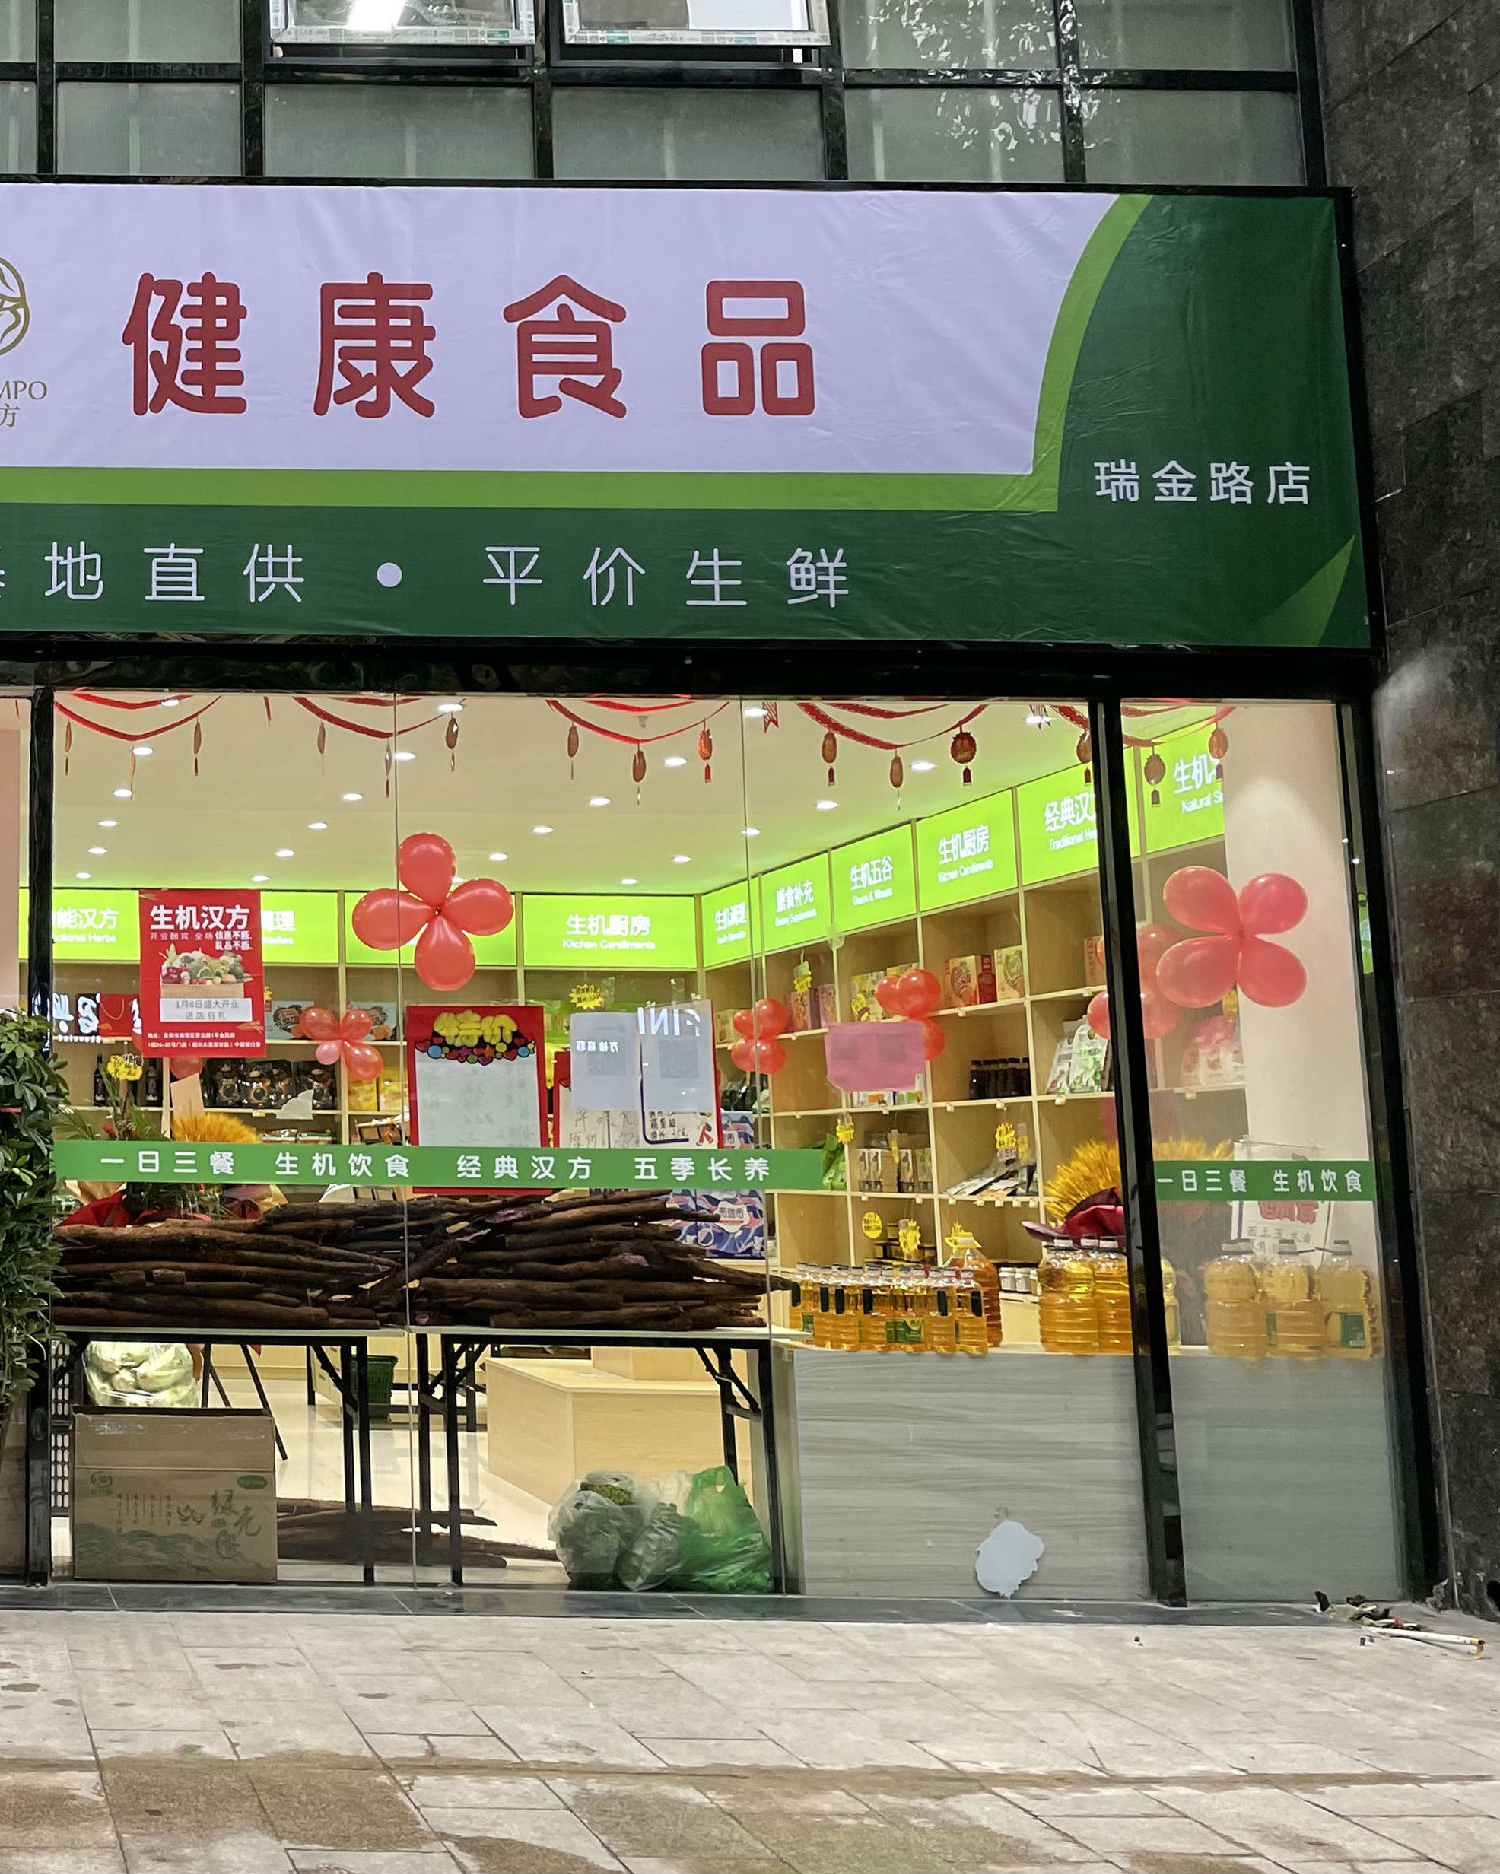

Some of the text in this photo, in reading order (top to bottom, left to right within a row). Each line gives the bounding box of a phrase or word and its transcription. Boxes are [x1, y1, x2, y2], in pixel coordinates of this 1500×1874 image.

[122, 271, 815, 419] 健康食品
[1094, 458, 1311, 506] 瑞金路店
[483, 547, 848, 608] 平价生鲜
[1044, 792, 1096, 832] 经典汉
[150, 904, 250, 930] 生机汉方
[100, 1151, 771, 1182] 一日三餐 生机饮食 经典汉方 五季长养
[1157, 1169, 1362, 1193] 一日三餐 生机饮食
